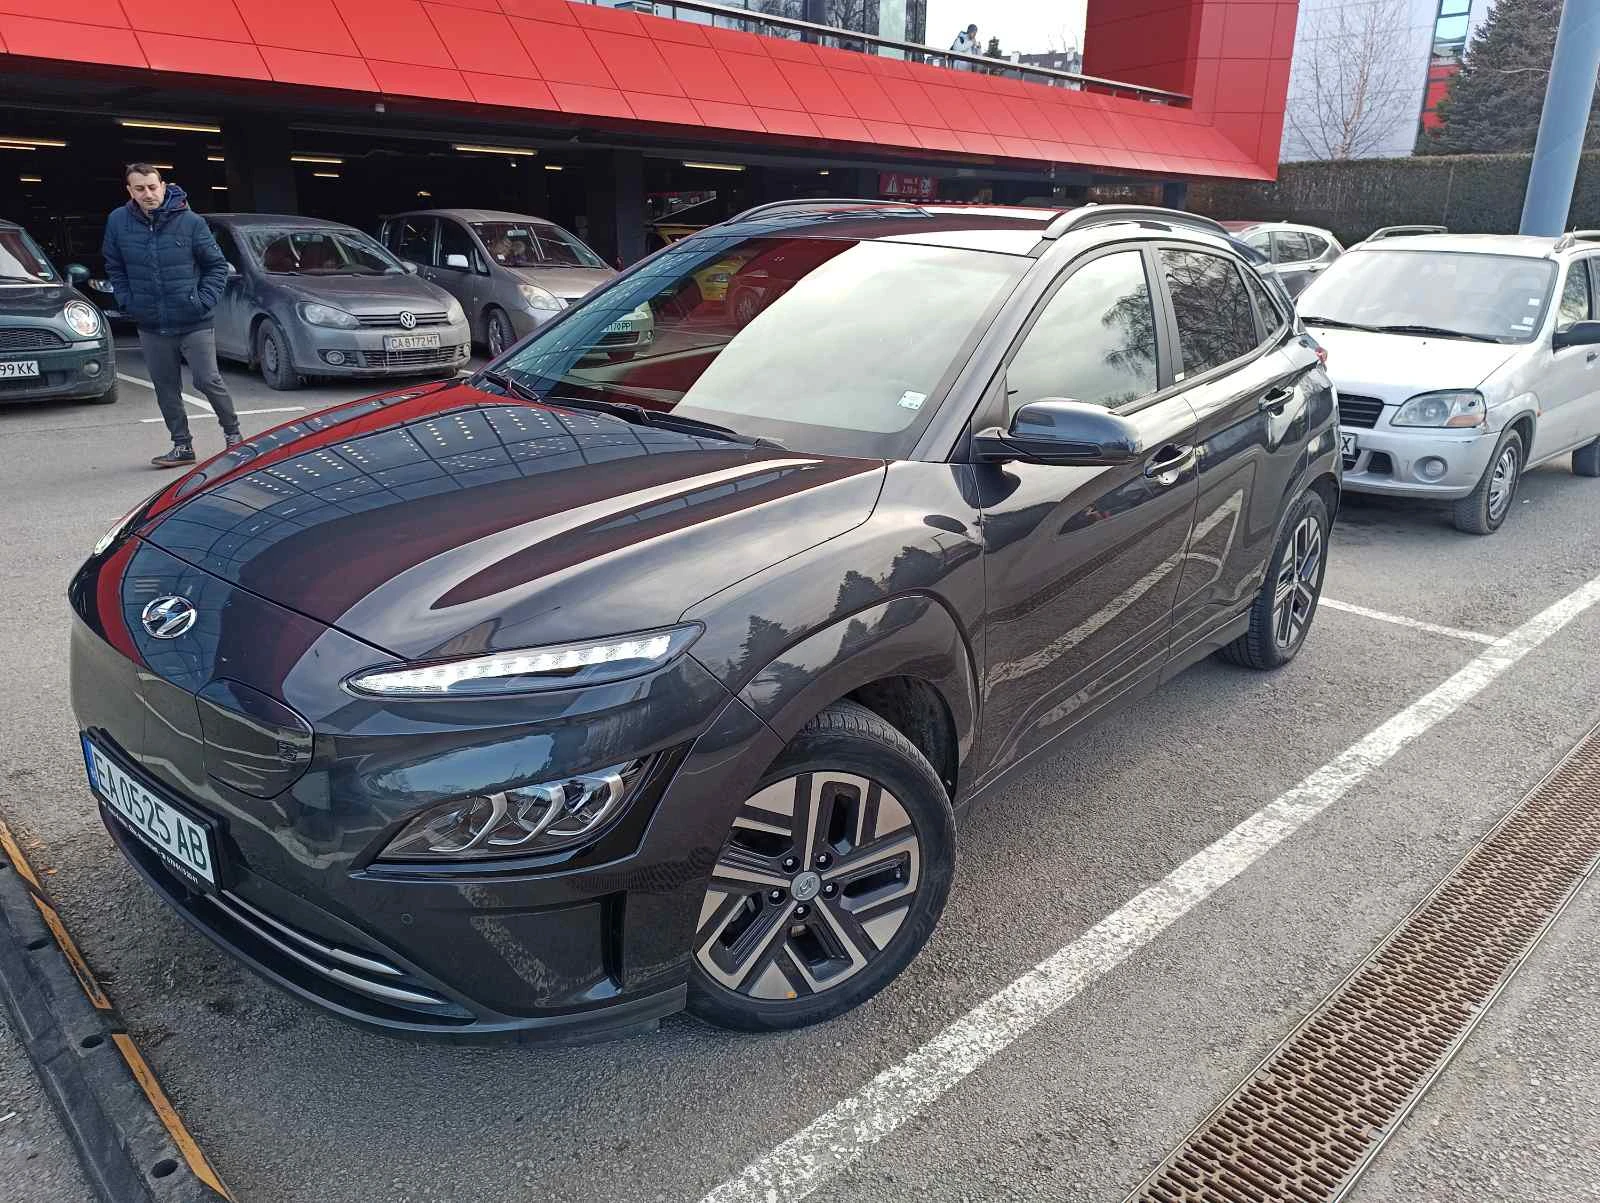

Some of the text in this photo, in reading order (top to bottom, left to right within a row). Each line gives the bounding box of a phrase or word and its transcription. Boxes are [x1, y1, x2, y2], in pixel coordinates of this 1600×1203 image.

[17, 362, 36, 375] KK
[93, 752, 121, 807] EA
[119, 776, 172, 845] 0525
[176, 816, 207, 870] AB
